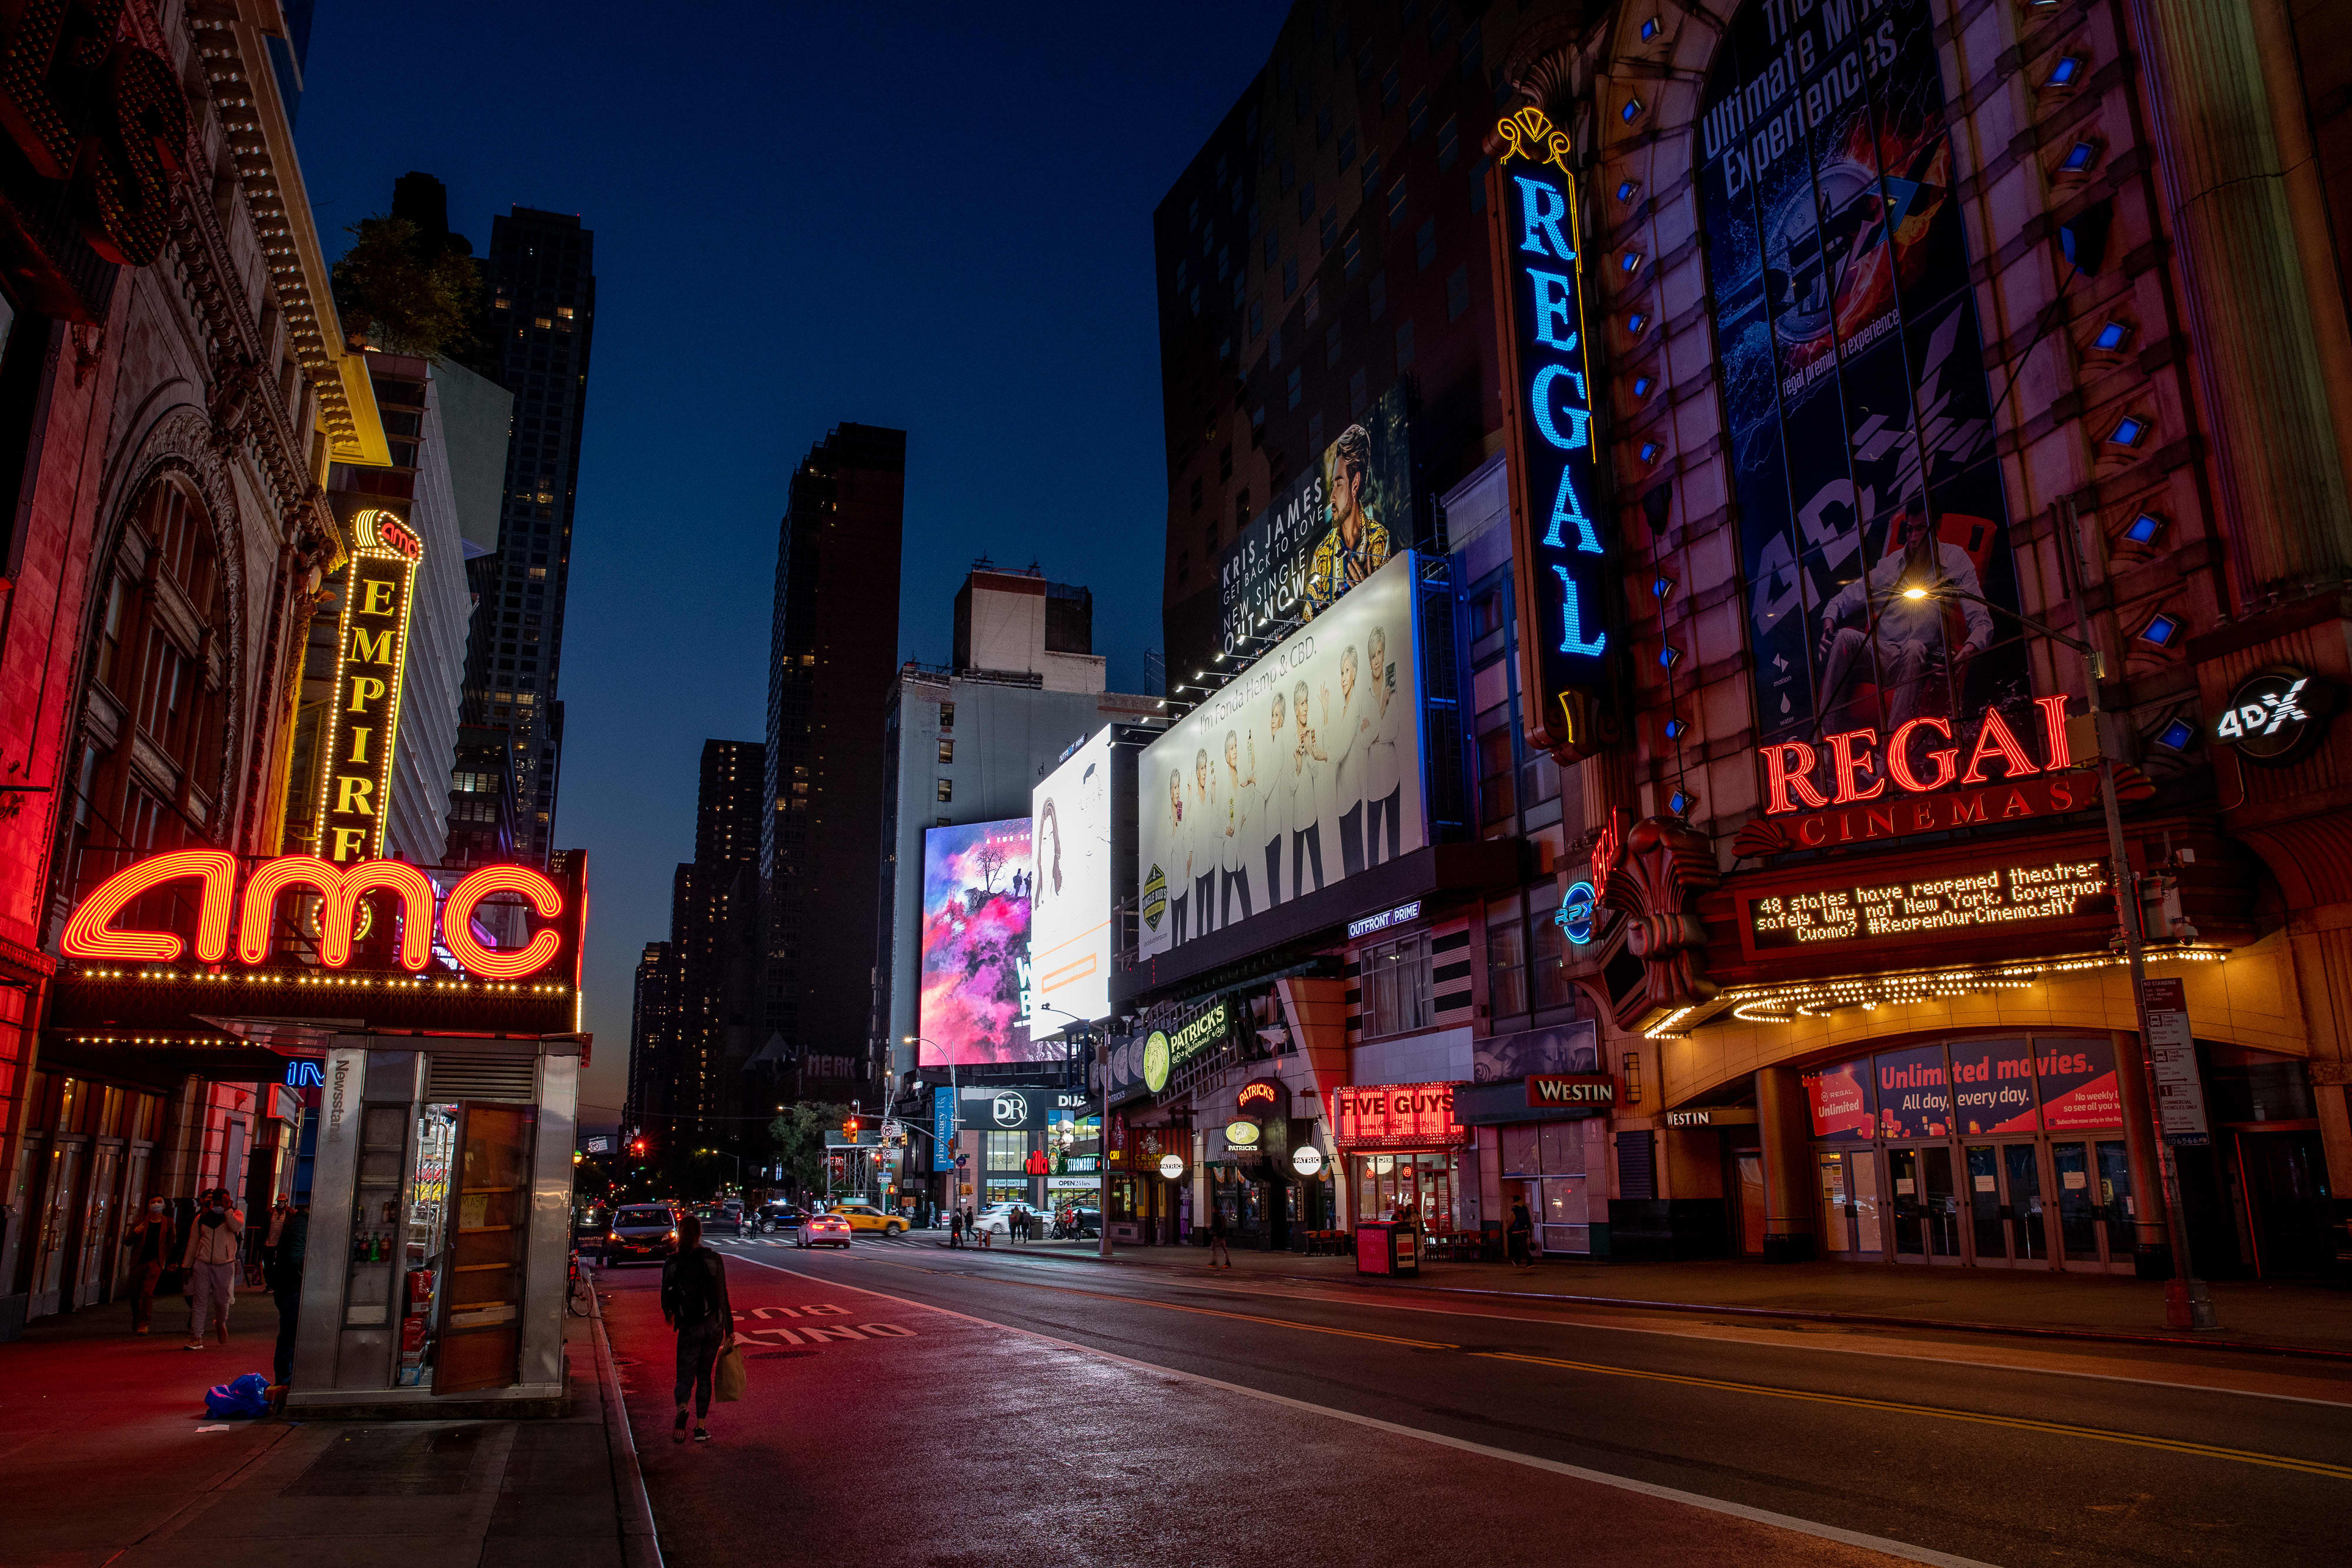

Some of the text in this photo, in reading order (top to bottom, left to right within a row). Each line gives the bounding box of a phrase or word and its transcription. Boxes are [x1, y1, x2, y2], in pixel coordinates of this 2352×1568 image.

[1703, 29, 1816, 160] Ultimate
[1722, 19, 1897, 200] Experiences
[1782, 369, 1805, 397] regal
[1847, 308, 1900, 359] experience
[1513, 175, 1608, 658] REGAL
[381, 522, 418, 559] amc
[1223, 477, 1322, 589] KRIS JAMES
[1223, 504, 1323, 605] GET BACK TO LOVE
[1224, 547, 1305, 634] NEW SINGLE
[1224, 612, 1254, 655] OUT
[1264, 569, 1305, 620] NOW
[1200, 716, 1214, 735] I'm
[1215, 689, 1244, 725] Fonda
[1246, 666, 1277, 703] Hemp
[1279, 654, 1288, 677] &
[1289, 636, 1317, 668] CBD.
[1773, 675, 1792, 688] motion
[333, 579, 396, 862] EMPIRE
[1779, 715, 1795, 726] water
[2217, 677, 2309, 738] 4DX
[1799, 781, 2073, 845] CINEMAS
[60, 848, 563, 979] amc
[1143, 892, 1155, 908] UNCLE
[1555, 899, 1595, 925] RPX
[1758, 881, 2107, 931] safely. Why not New York, Governor
[1760, 897, 1782, 914] 48
[1791, 892, 1848, 911] states
[1856, 887, 1903, 903] have
[1912, 871, 1999, 897] reopened
[1349, 904, 1418, 937] OUTFRONT PRIME
[1797, 897, 2076, 941] Cuomo? #ReopenOurCinemasNY
[1170, 1004, 1225, 1054] PATRICK'S
[1184, 1029, 1212, 1058] Restaurant
[1881, 1048, 2094, 1090] Unlimited movies.
[328, 1059, 350, 1143] Newsstand
[1238, 1083, 1275, 1106] PATRICK'S
[1340, 1094, 1454, 1116] FIVE GUYS
[1538, 1080, 1612, 1101] WESTIN
[1818, 1099, 1859, 1118] Unlimited
[1829, 1089, 1853, 1099] REGAL
[1902, 1086, 2030, 1112] All day, every day.
[2075, 1093, 2086, 1101] No
[2086, 1091, 2113, 1102] weekly
[2087, 1102, 2097, 1111] all
[2098, 1104, 2112, 1113] you
[936, 1111, 947, 1164] pharmacy
[1666, 1111, 1710, 1126] WESTIN
[1025, 1149, 1049, 1175] villa
[1067, 1157, 1096, 1172] STROMBOLI
